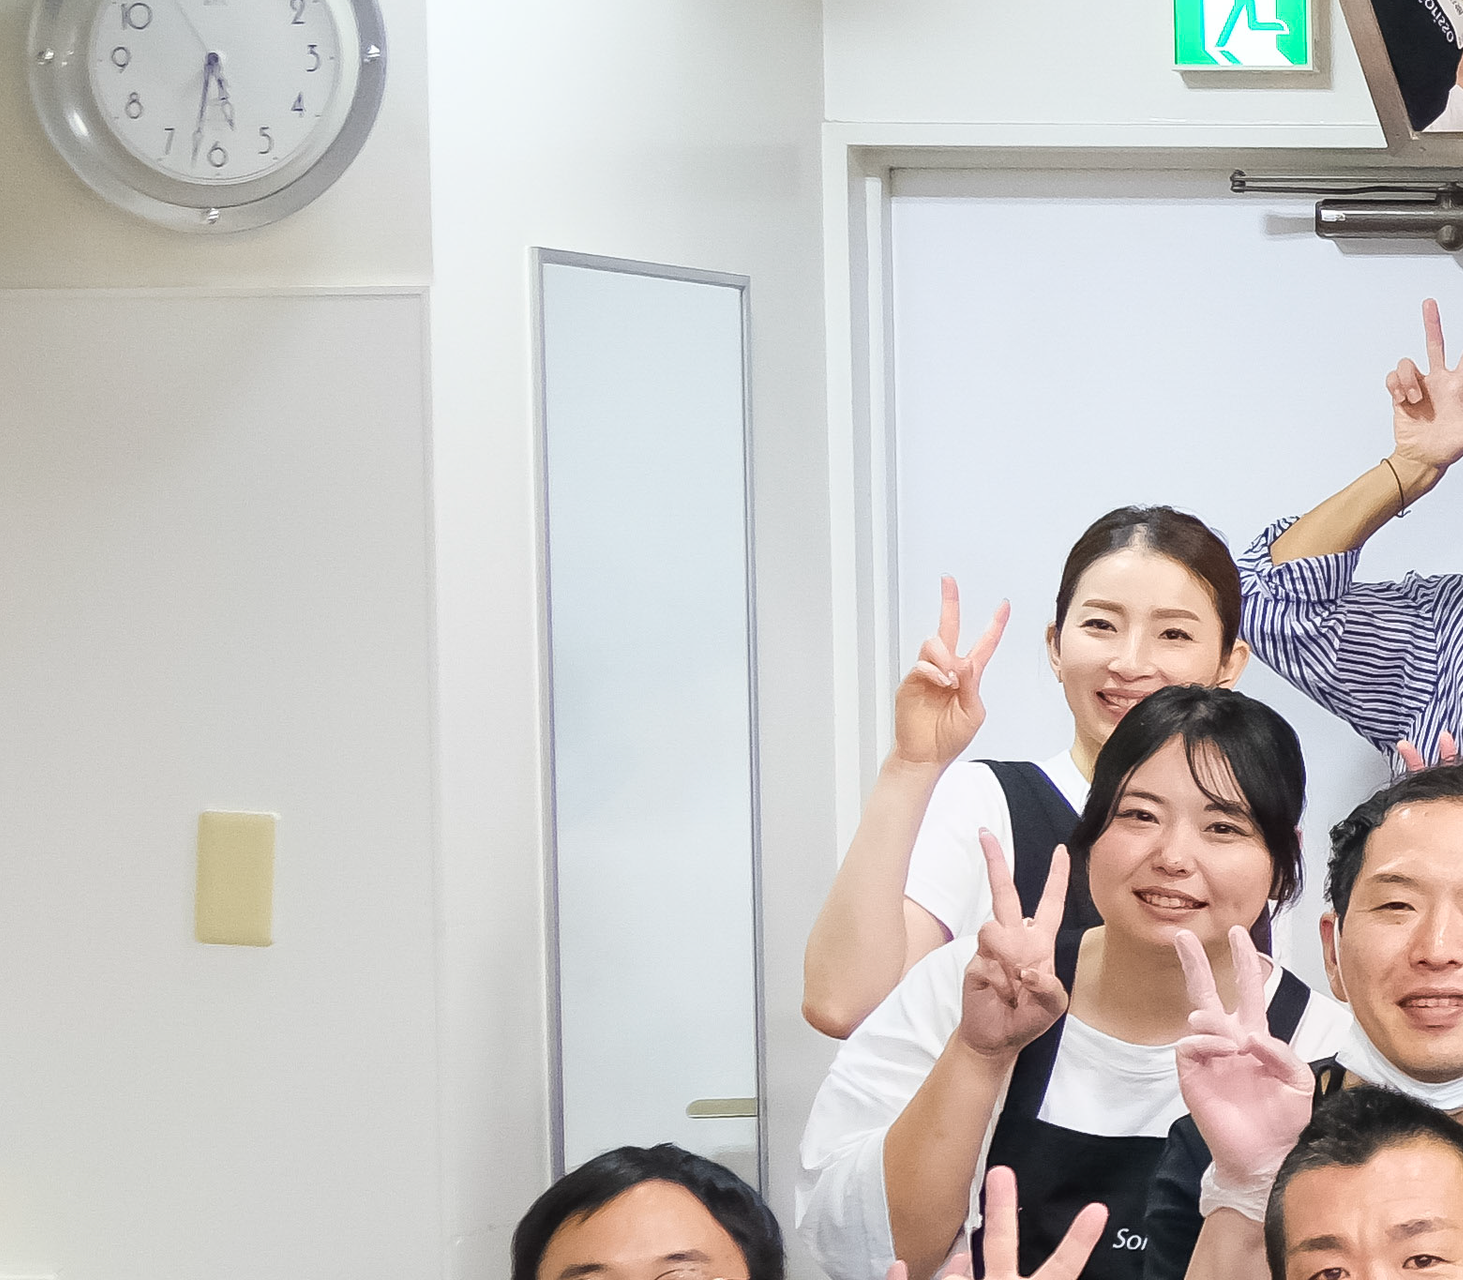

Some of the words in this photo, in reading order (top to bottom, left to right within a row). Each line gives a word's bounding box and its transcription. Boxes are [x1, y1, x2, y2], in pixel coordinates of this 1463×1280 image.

[110, 45, 131, 73] 9
[305, 44, 321, 73] 3
[125, 92, 143, 119] 8
[291, 92, 305, 117] 4
[163, 128, 175, 155] 7
[207, 141, 229, 168] 6
[258, 127, 274, 155] 5
